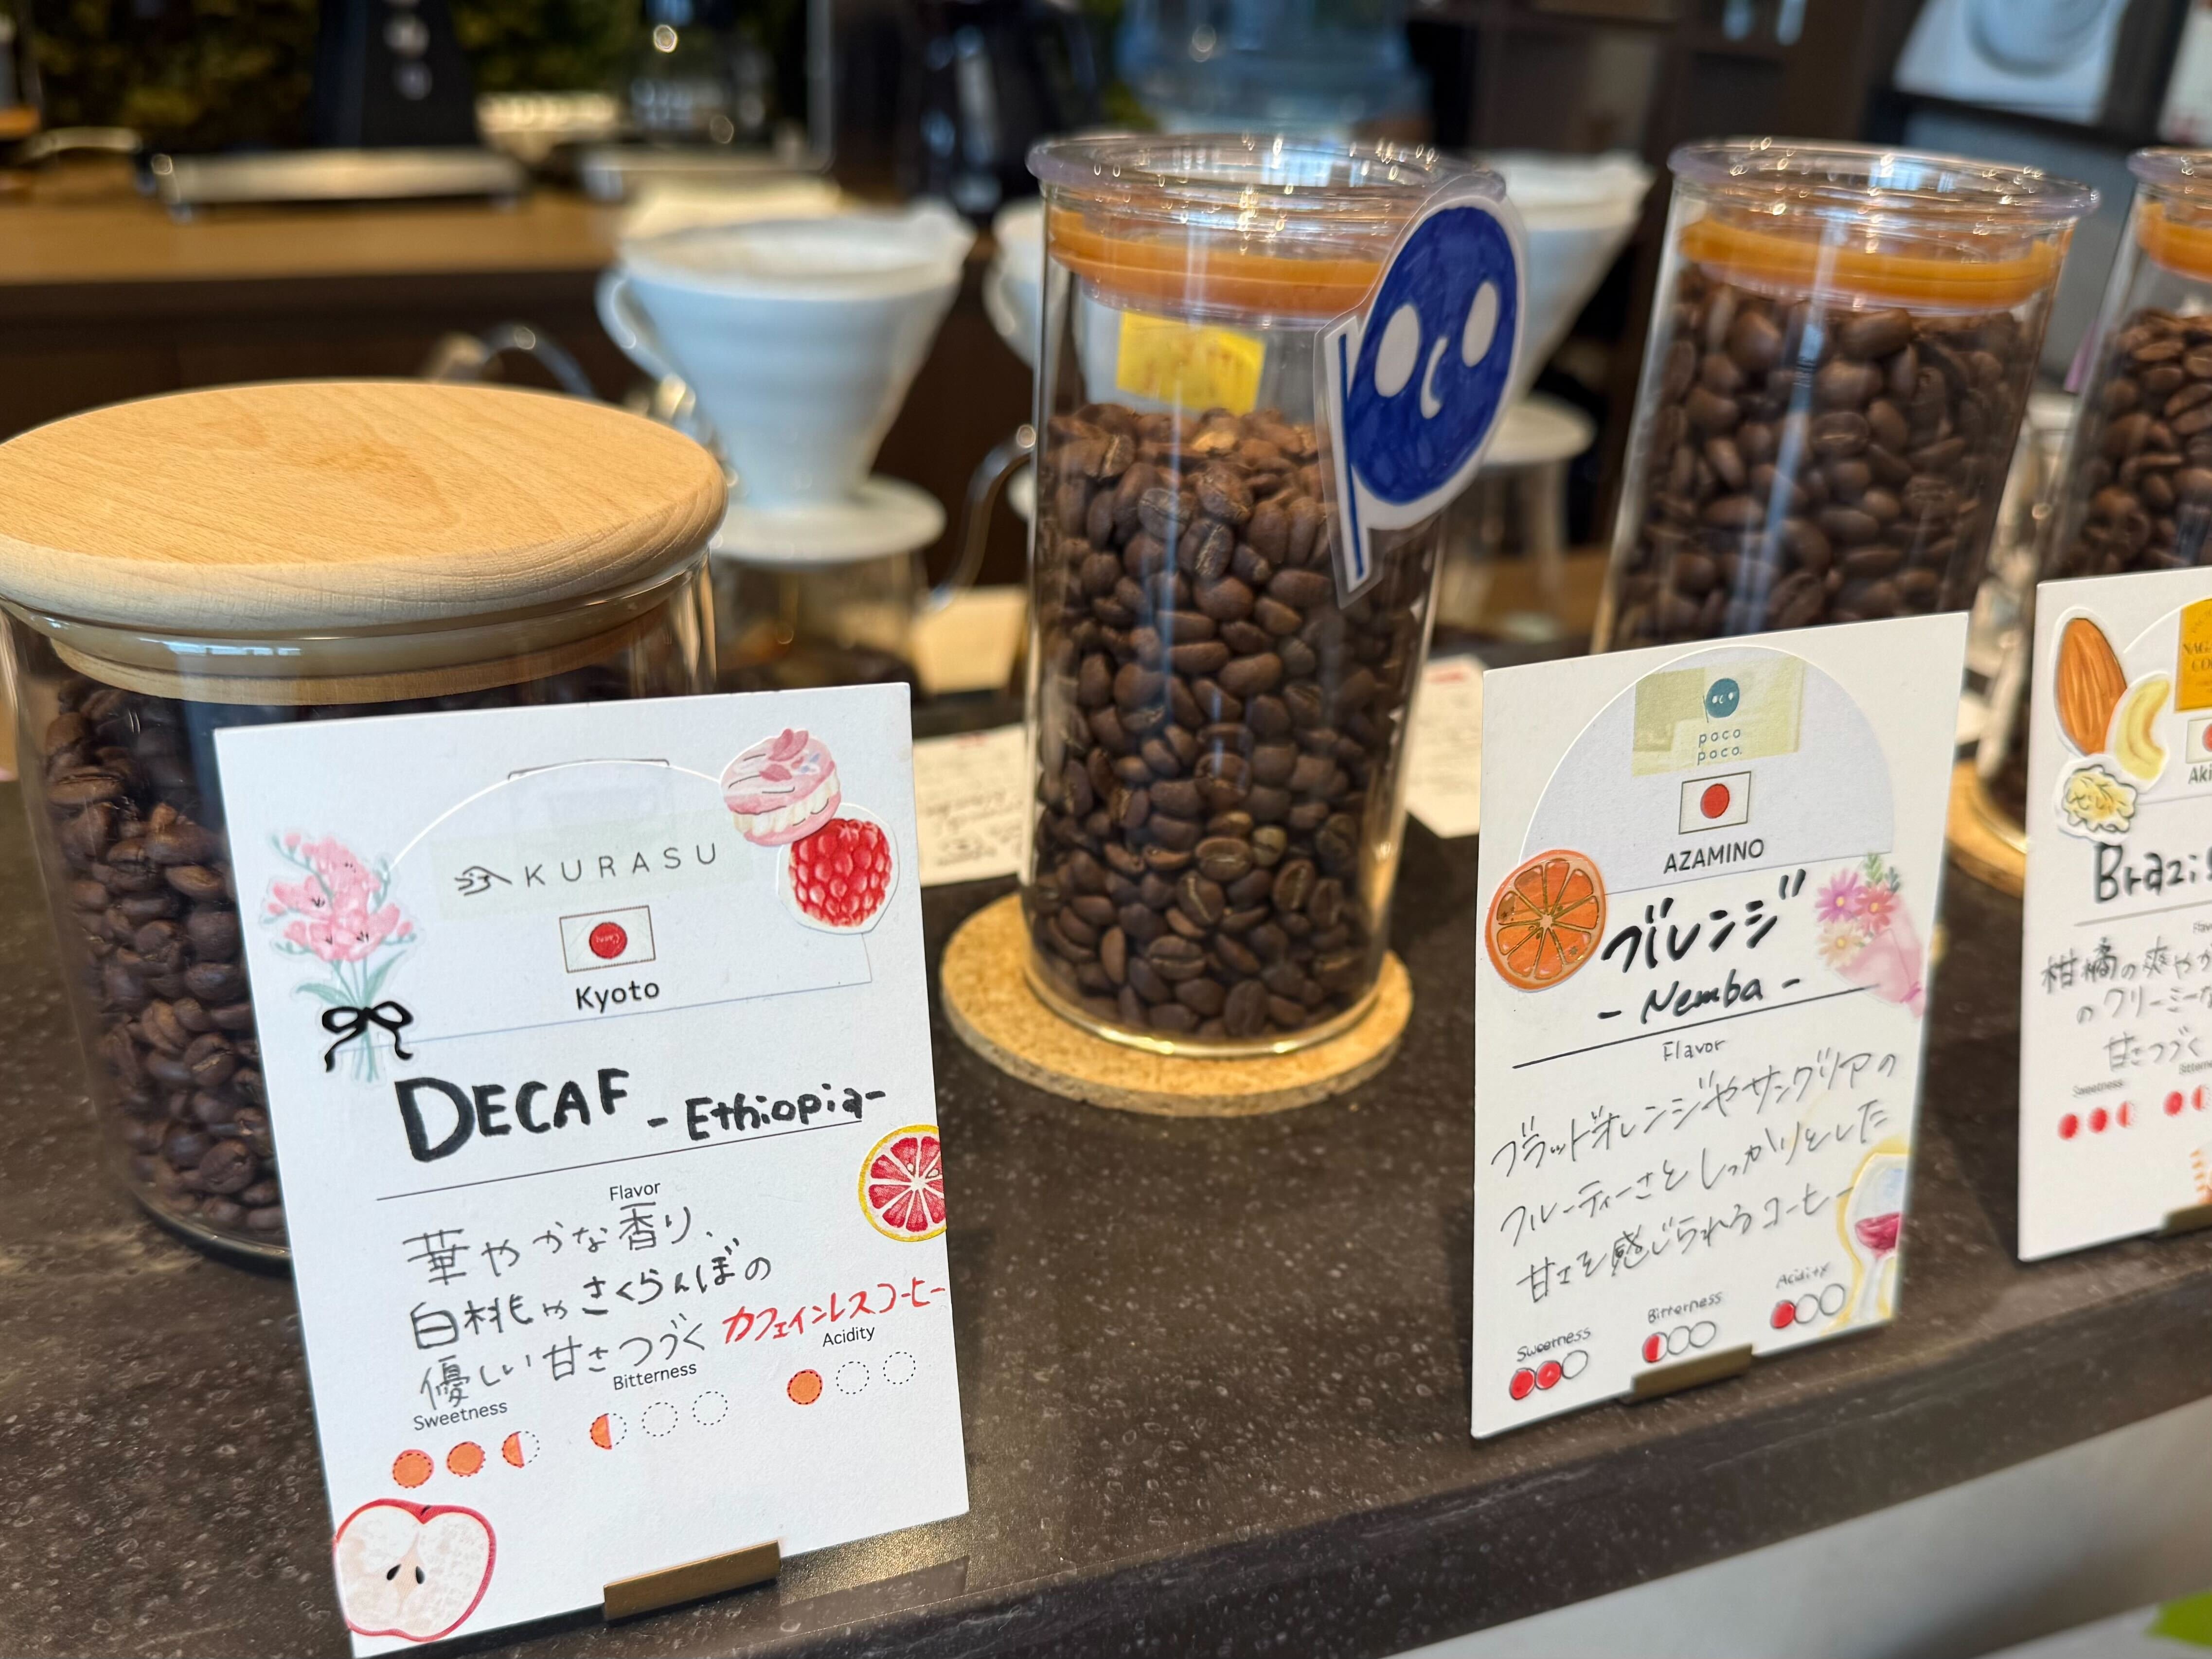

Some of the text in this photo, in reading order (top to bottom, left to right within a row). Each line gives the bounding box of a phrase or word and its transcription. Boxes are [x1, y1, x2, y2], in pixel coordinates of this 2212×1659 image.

[1698, 729, 1741, 749] poco
[525, 842, 717, 888] KURASU
[1664, 838, 1764, 874] AZAMINO
[2094, 843, 2212, 904] Brazi
[576, 981, 660, 1014] Kyoto
[1642, 969, 1763, 1022] Nemba
[1662, 1040, 1726, 1061] Flavor
[394, 1068, 629, 1163] DECAF
[610, 1183, 660, 1201] Flavor
[1776, 1262, 1830, 1289] Acidity
[410, 1238, 772, 1350] 白桃やさくらんぼの
[1648, 1292, 1722, 1324] Bitterness
[419, 1277, 946, 1409] 優しい甘さつづく カフェインレスコーヒー
[822, 1327, 874, 1347] Acidity
[1517, 1327, 1591, 1363] Sweetness
[613, 1364, 696, 1390] Bitterness
[413, 1403, 507, 1430] Sweetness
